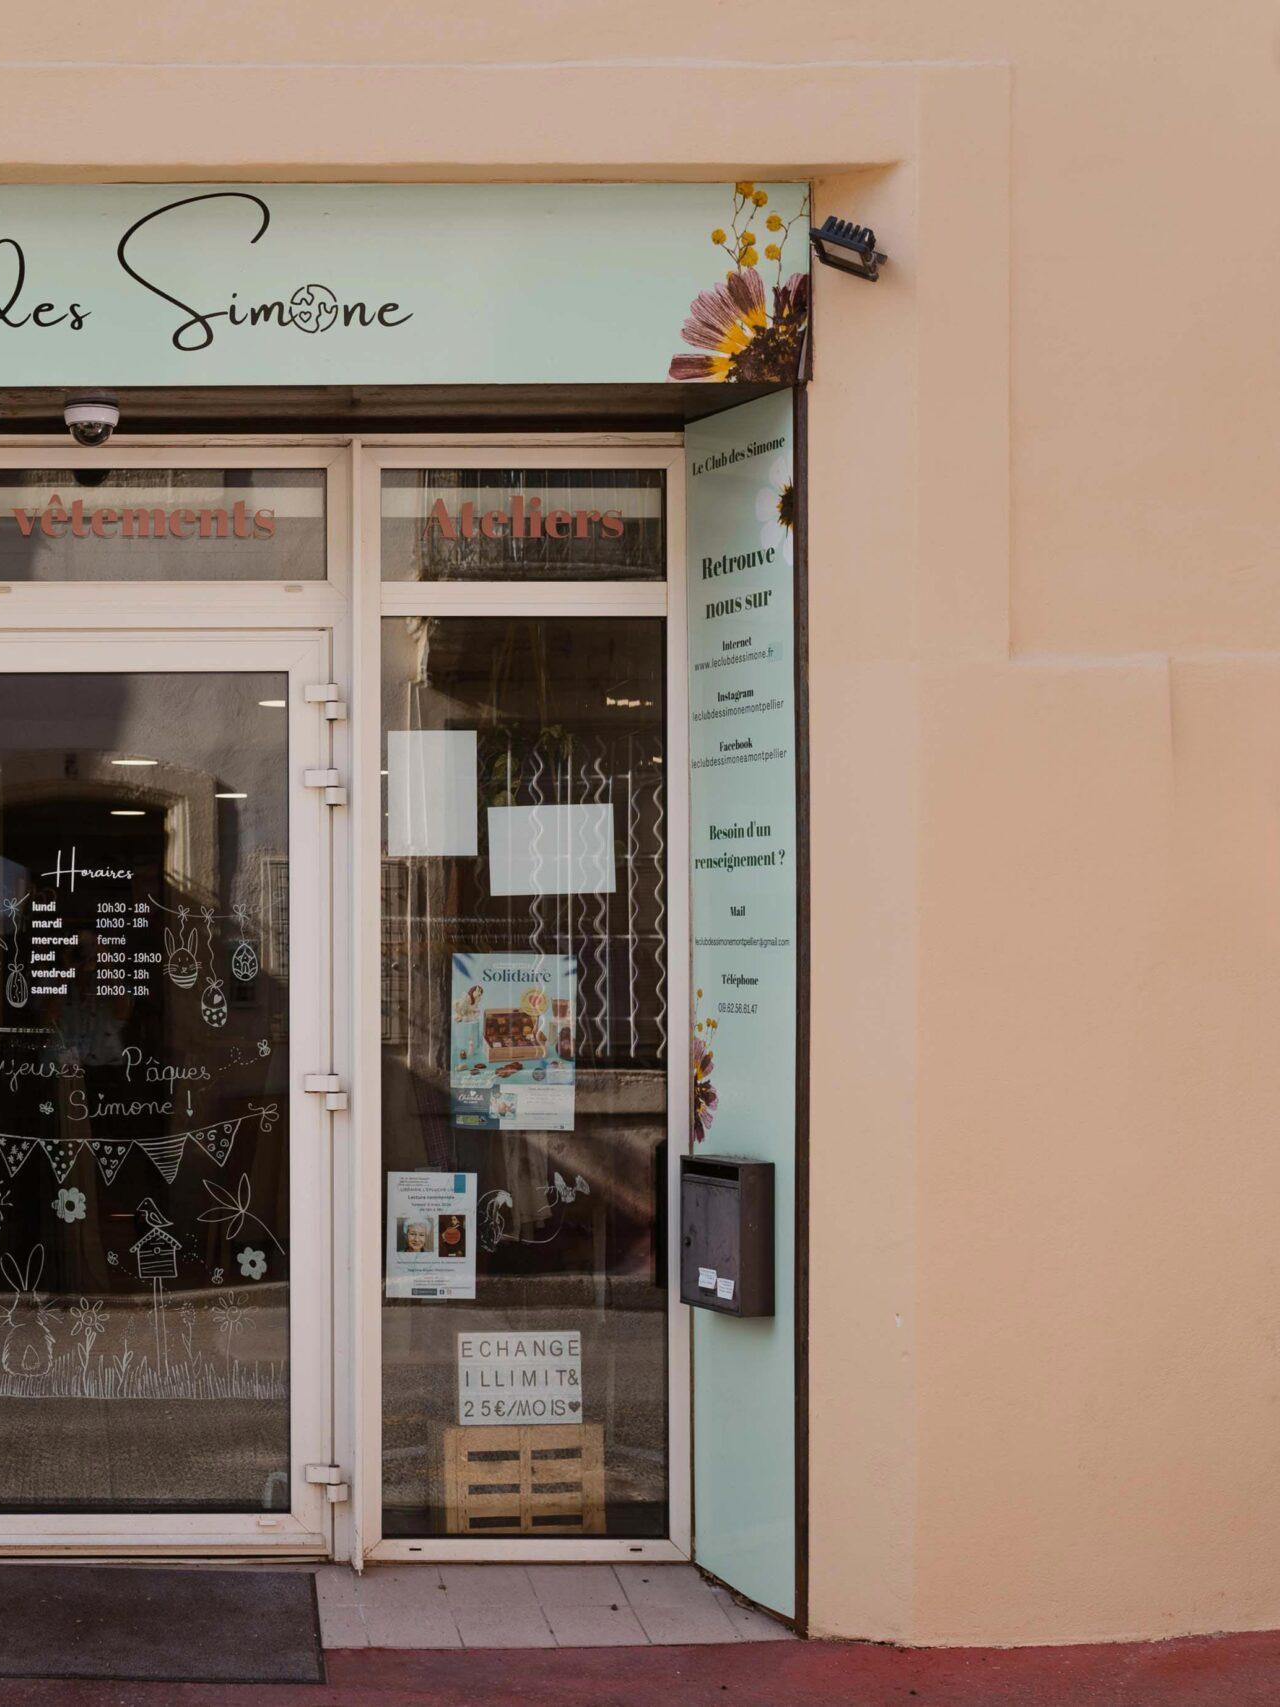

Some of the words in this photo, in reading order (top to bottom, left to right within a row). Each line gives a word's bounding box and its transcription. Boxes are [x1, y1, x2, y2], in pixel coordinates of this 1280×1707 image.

[692, 462, 704, 476] Le
[705, 453, 727, 471] Club
[729, 447, 745, 465] des
[746, 435, 786, 459] Simone
[11, 494, 276, 540] vêtements
[422, 496, 625, 539] Ateliers
[702, 546, 776, 580] Retrouve
[705, 597, 742, 619] nous
[745, 589, 773, 612] sur
[722, 636, 752, 651] Internet
[717, 689, 754, 703] Instagram
[719, 738, 753, 752] Facebook
[709, 822, 744, 841] Besoin
[746, 821, 771, 839] d'un
[41, 846, 135, 892] Horaires
[695, 850, 776, 872] renseignement
[32, 901, 56, 912] lundi
[97, 903, 126, 913] 10h30
[134, 903, 150, 913] 18h
[730, 905, 746, 917] Mail
[32, 918, 62, 928] mardi
[96, 918, 124, 928] 10h30
[133, 918, 148, 928] 18h
[31, 935, 79, 945] mercredi
[97, 934, 126, 945] fermé
[30, 951, 56, 963] jeudi
[96, 952, 125, 963] 10h30
[133, 952, 162, 963] 19h30
[31, 968, 76, 978] vendredi
[96, 969, 125, 979] 10h30
[133, 969, 149, 979] 18h
[482, 967, 552, 983] Solidaire
[721, 974, 759, 988] Téléphone
[31, 984, 68, 995] samedi
[96, 985, 125, 996] 10h30
[133, 985, 149, 995] 18h
[122, 1046, 211, 1094] Pâques
[67, 1090, 175, 1120] Simone
[462, 1340, 580, 1358] ECHANGE
